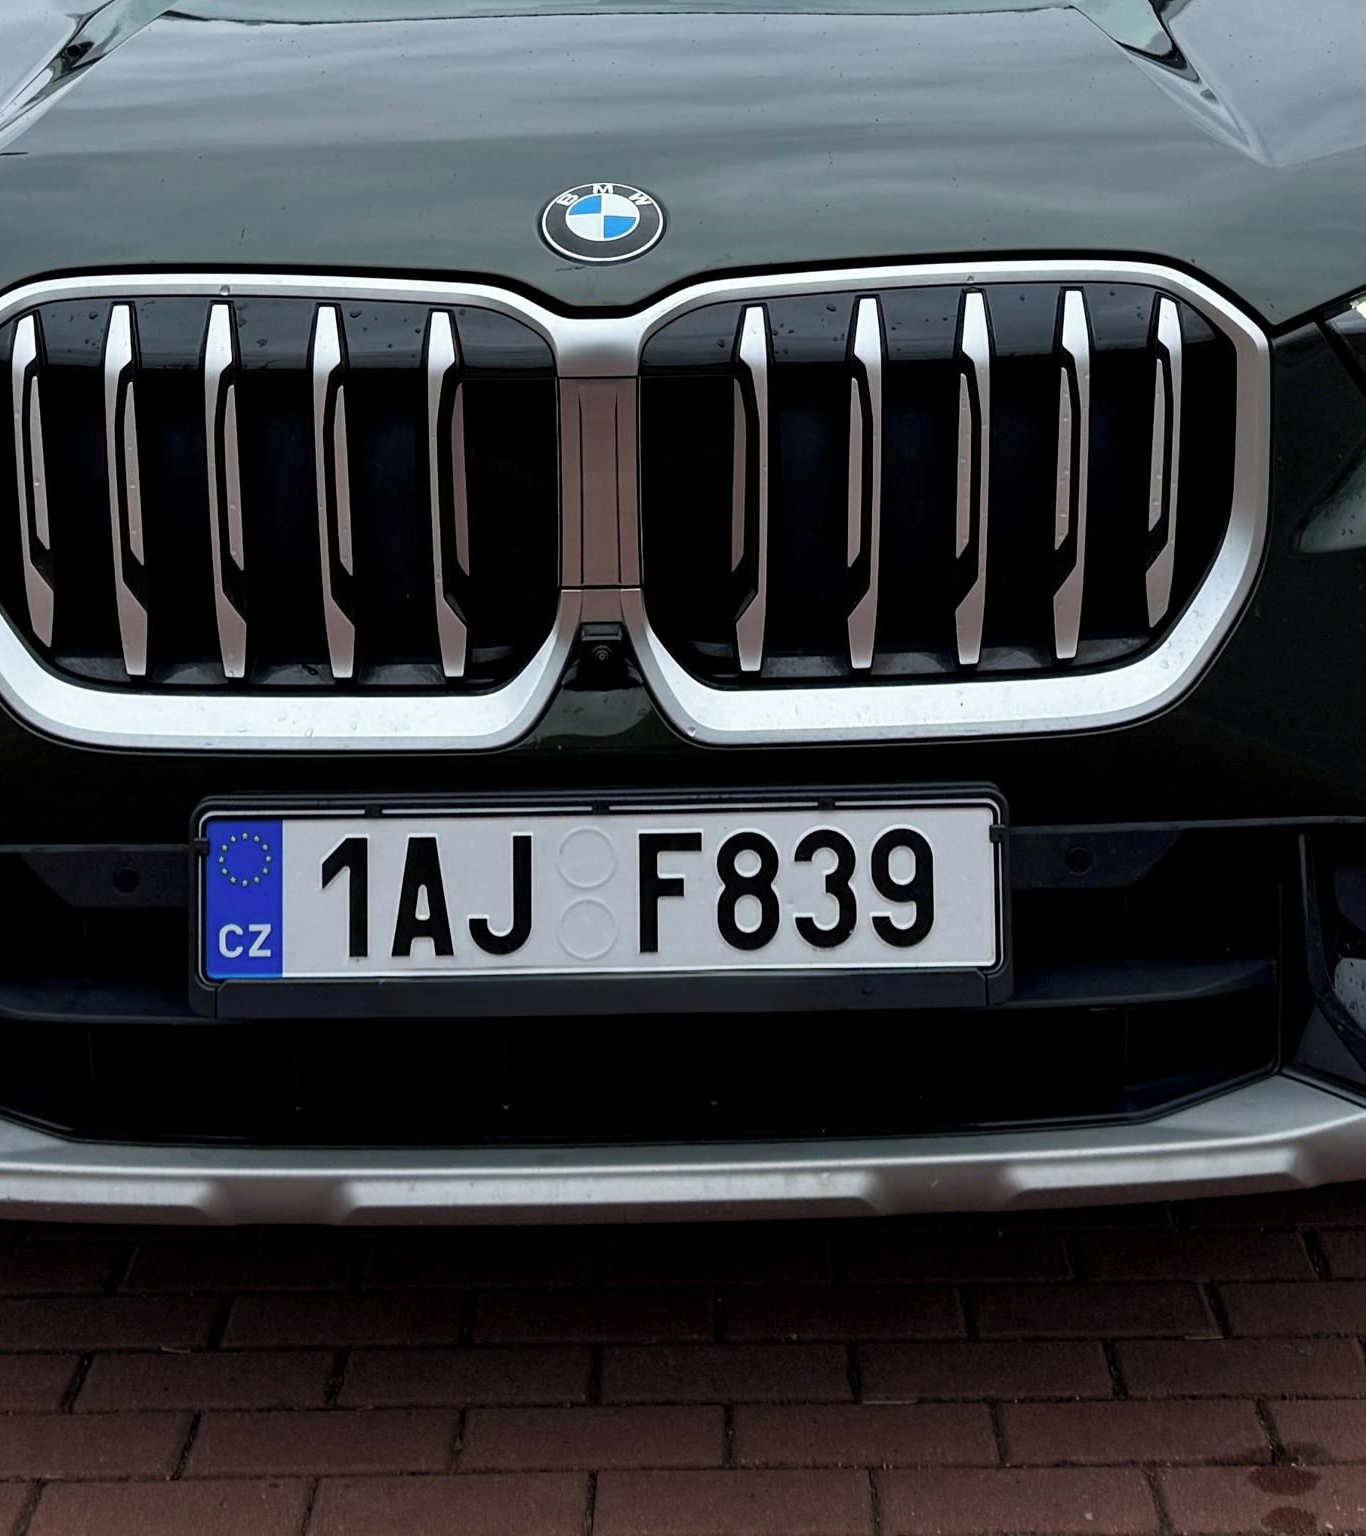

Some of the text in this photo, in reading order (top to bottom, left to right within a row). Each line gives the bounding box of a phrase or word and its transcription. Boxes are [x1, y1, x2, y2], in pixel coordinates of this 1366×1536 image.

[556, 184, 652, 206] BMW
[321, 828, 935, 958] 1AJ F839
[218, 923, 272, 959] CZ
